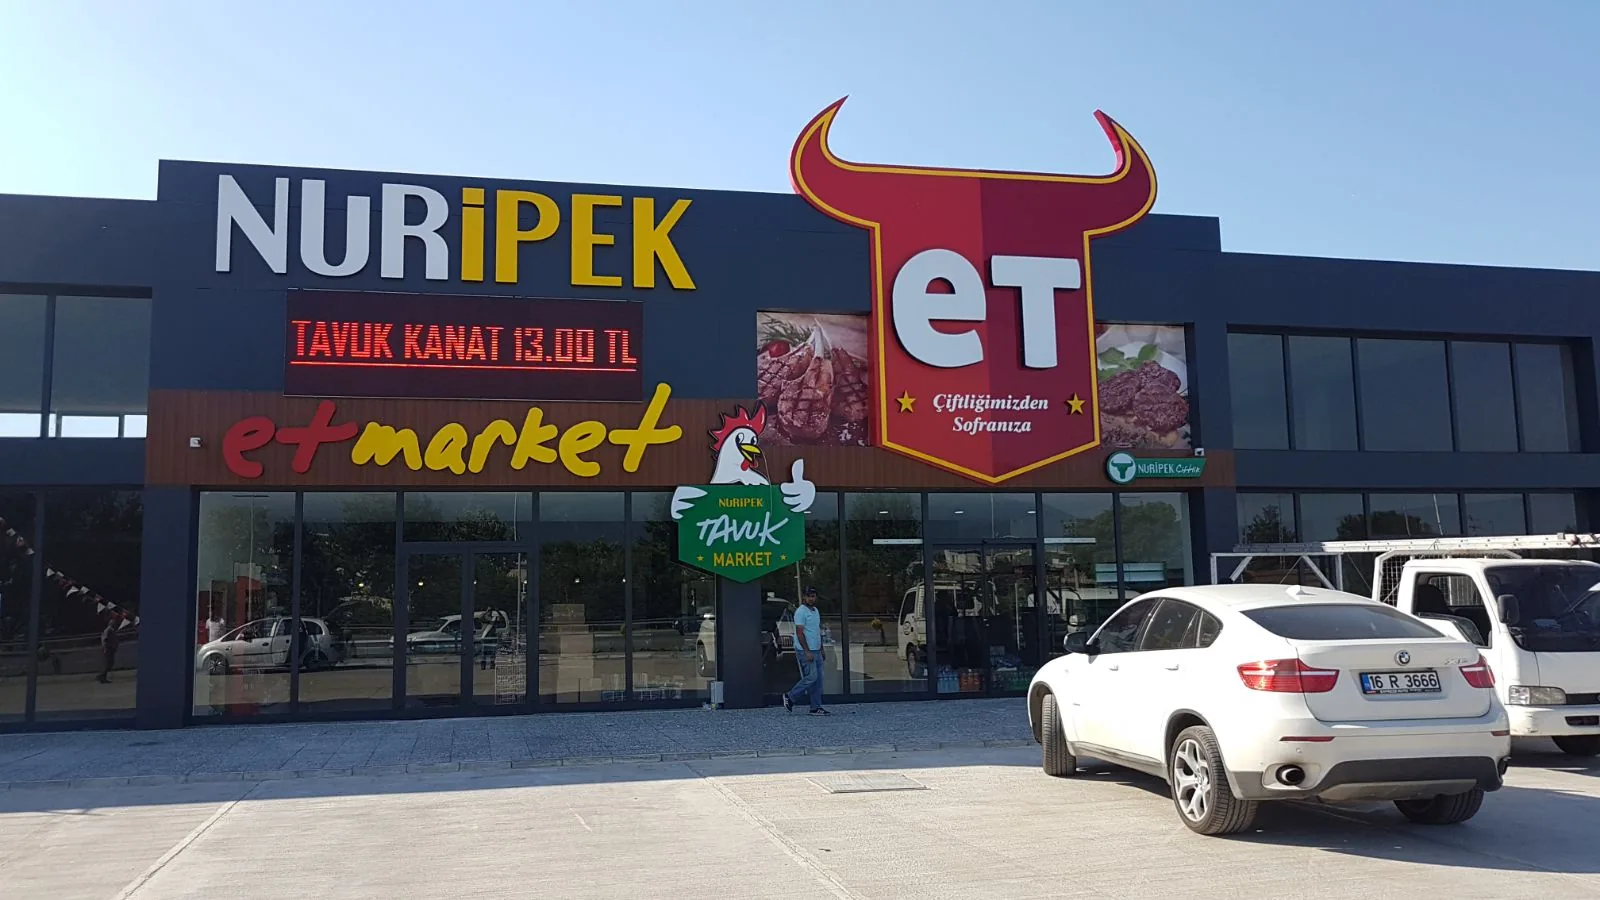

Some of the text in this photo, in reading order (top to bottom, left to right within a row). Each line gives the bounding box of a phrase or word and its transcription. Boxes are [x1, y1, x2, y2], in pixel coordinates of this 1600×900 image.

[291, 320, 637, 364] TAVUK KANAT 13.00 TL
[932, 393, 1049, 413] Çiftliğimizden
[222, 383, 682, 478] et market
[952, 416, 1032, 435] Sofranıza
[696, 511, 789, 547] TAVUK
[713, 552, 772, 567] MARKET
[1369, 673, 1438, 689] 16 R 3666
